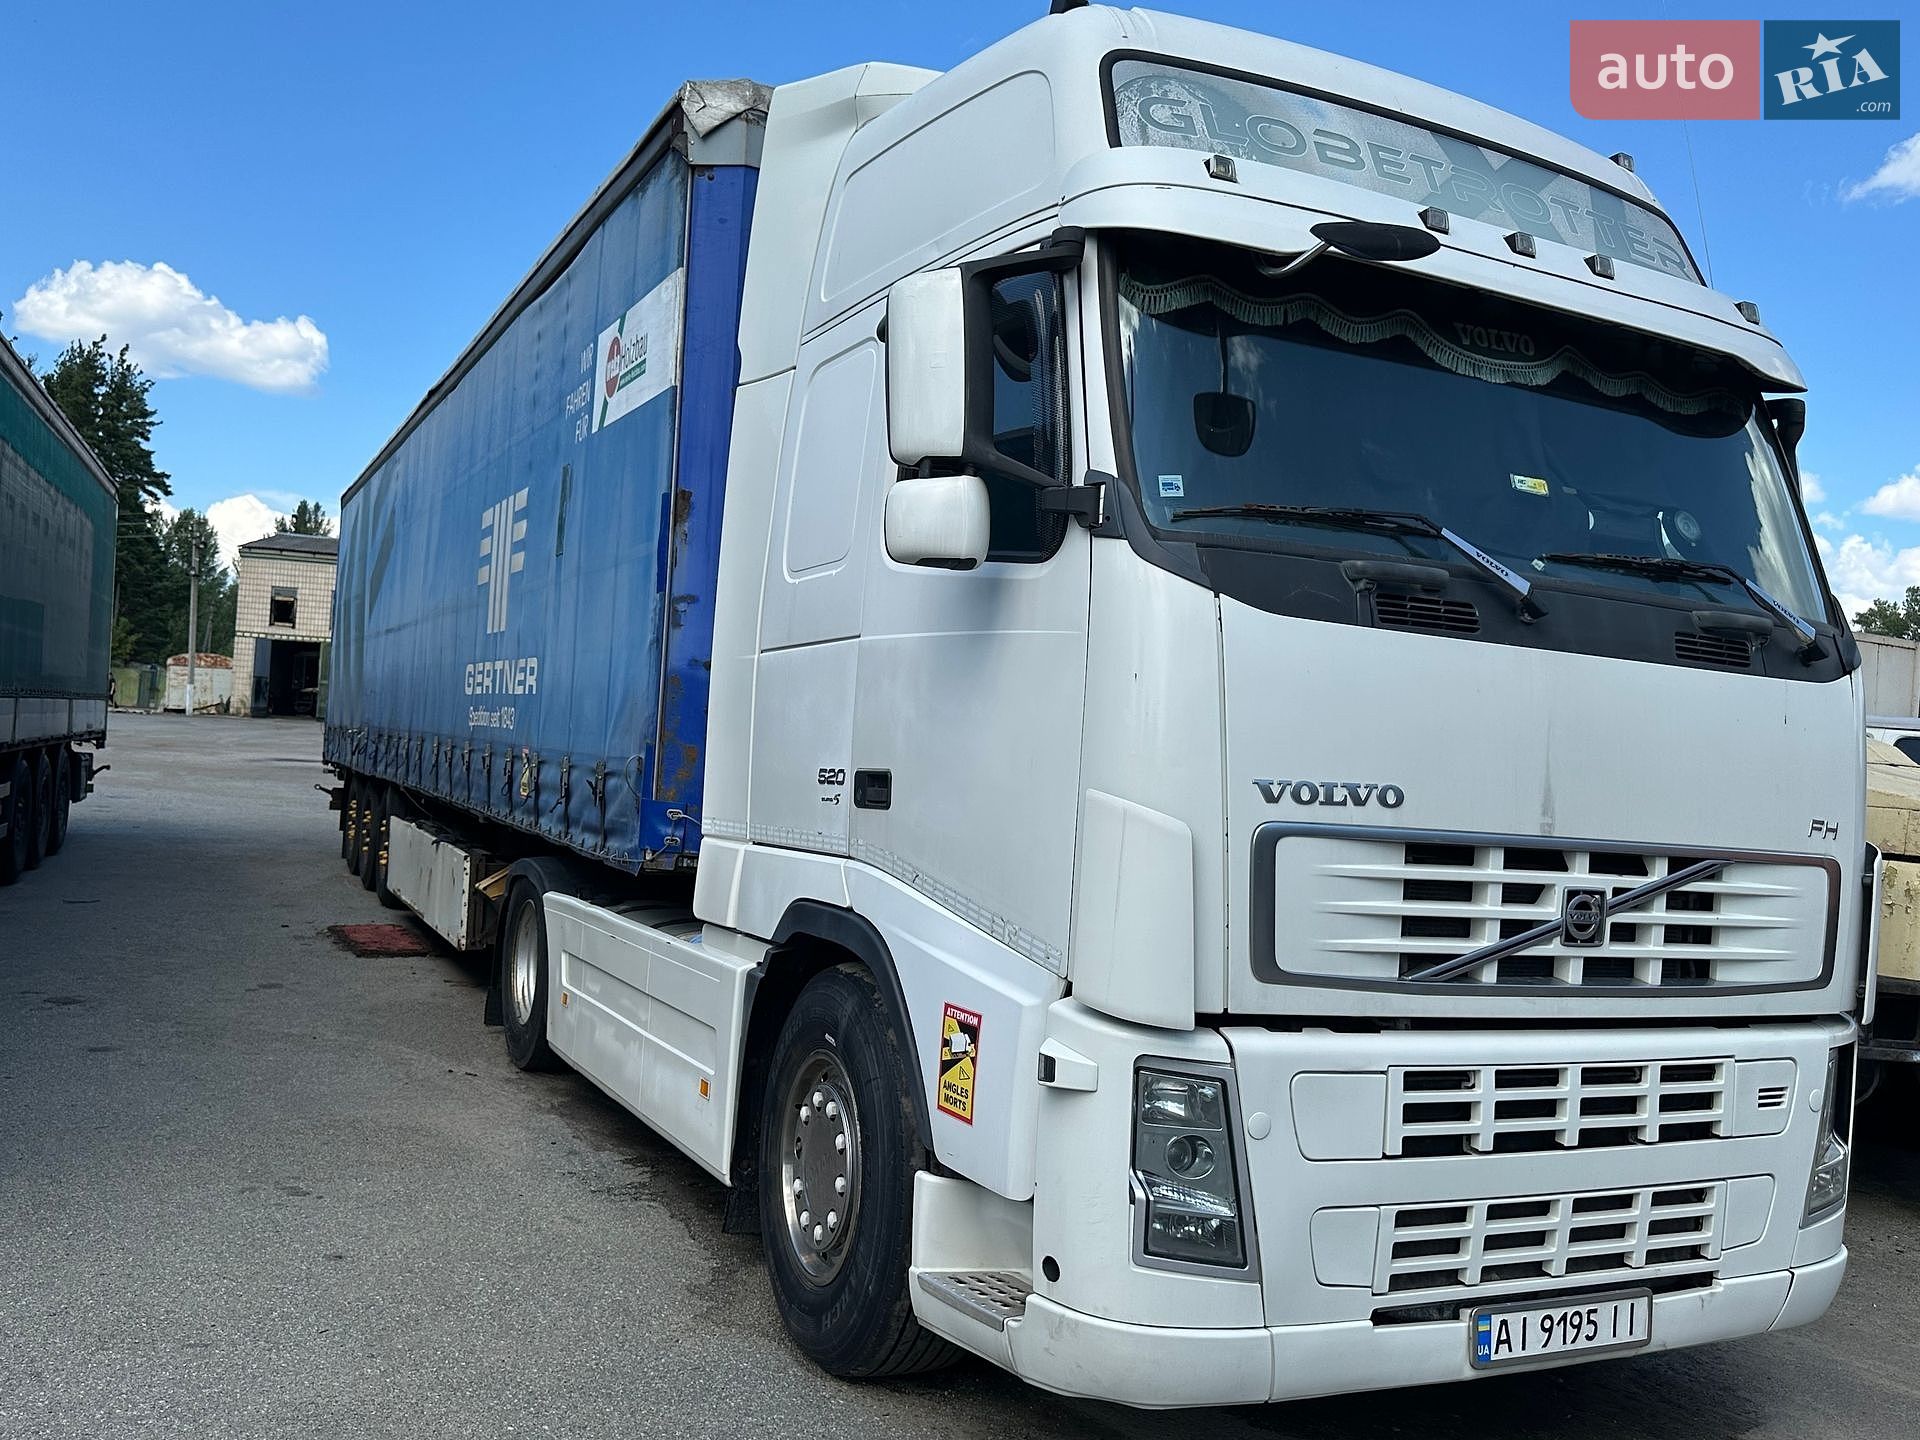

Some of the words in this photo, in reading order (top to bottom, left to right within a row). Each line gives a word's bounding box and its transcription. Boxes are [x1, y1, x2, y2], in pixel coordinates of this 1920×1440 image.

[1139, 97, 1692, 277] GLOBETROTTER
[1453, 321, 1535, 356] VOLVO
[566, 378, 592, 420] FAHREN
[575, 412, 589, 444] FÜR
[1475, 551, 1509, 577] VOLVO
[464, 657, 538, 695] GERTNER
[818, 768, 846, 785] 520
[1252, 778, 1405, 809] VOLVO
[1808, 818, 1839, 840] FH
[946, 1007, 978, 1025] ATTENTION
[943, 1080, 969, 1099] ANGLES
[943, 1093, 967, 1112] MORTS
[1477, 1345, 1490, 1356] UA
[1494, 1317, 1527, 1354] AI
[1540, 1308, 1598, 1348] 9195
[1612, 1302, 1635, 1338] II
